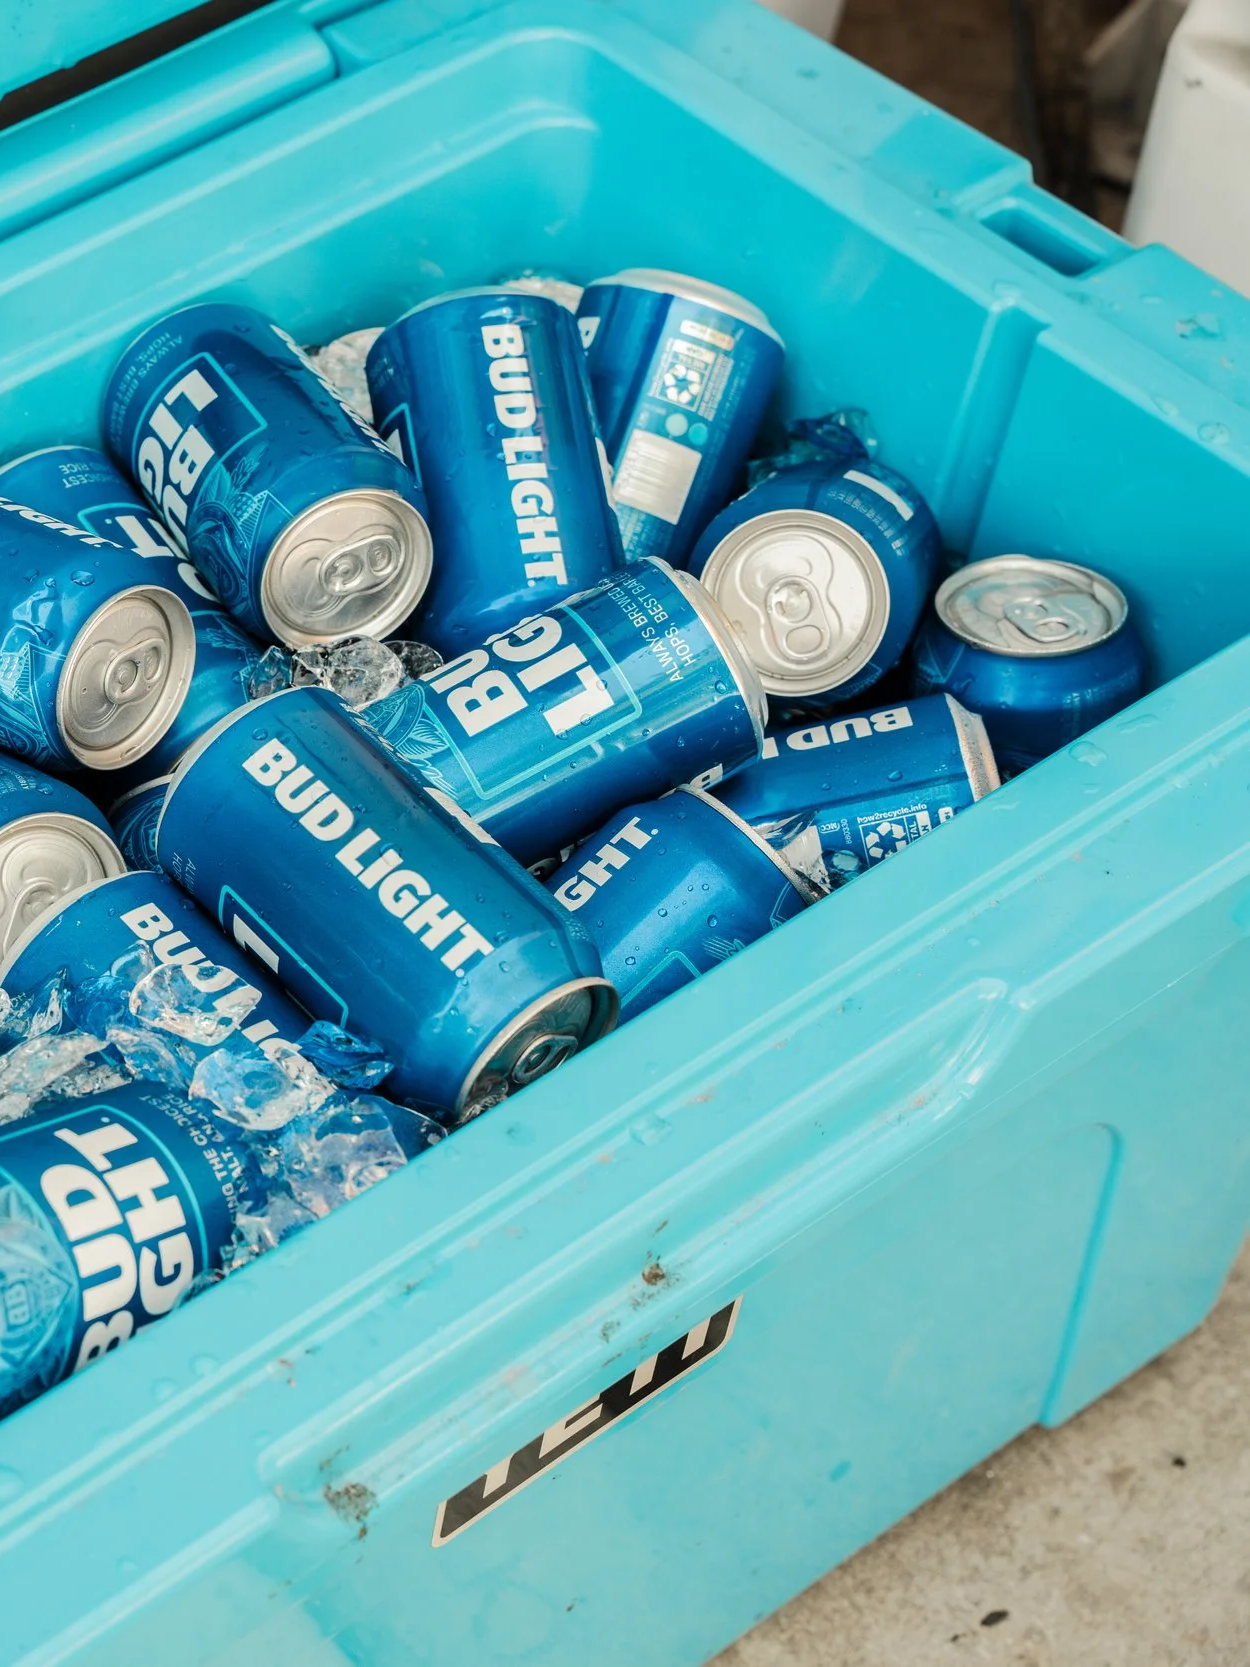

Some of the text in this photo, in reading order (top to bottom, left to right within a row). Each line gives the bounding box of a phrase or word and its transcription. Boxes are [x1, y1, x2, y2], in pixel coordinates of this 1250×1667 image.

[139, 369, 219, 506] LIG
[481, 324, 568, 588] BUD LIGHT.
[162, 425, 216, 560] BU
[607, 587, 684, 682] ALWAYS BREWED
[638, 594, 669, 624] BEST
[665, 622, 697, 667] HOPS,
[421, 648, 528, 738] BU
[483, 614, 615, 737] LIG
[786, 706, 914, 751] BUD
[241, 738, 355, 842] BUD
[335, 827, 495, 979] LIGHT.
[857, 802, 927, 824] how2recycle.info
[553, 816, 659, 912] GHT.
[203, 1148, 228, 1181] THE
[53, 1116, 194, 1316] GHT.
